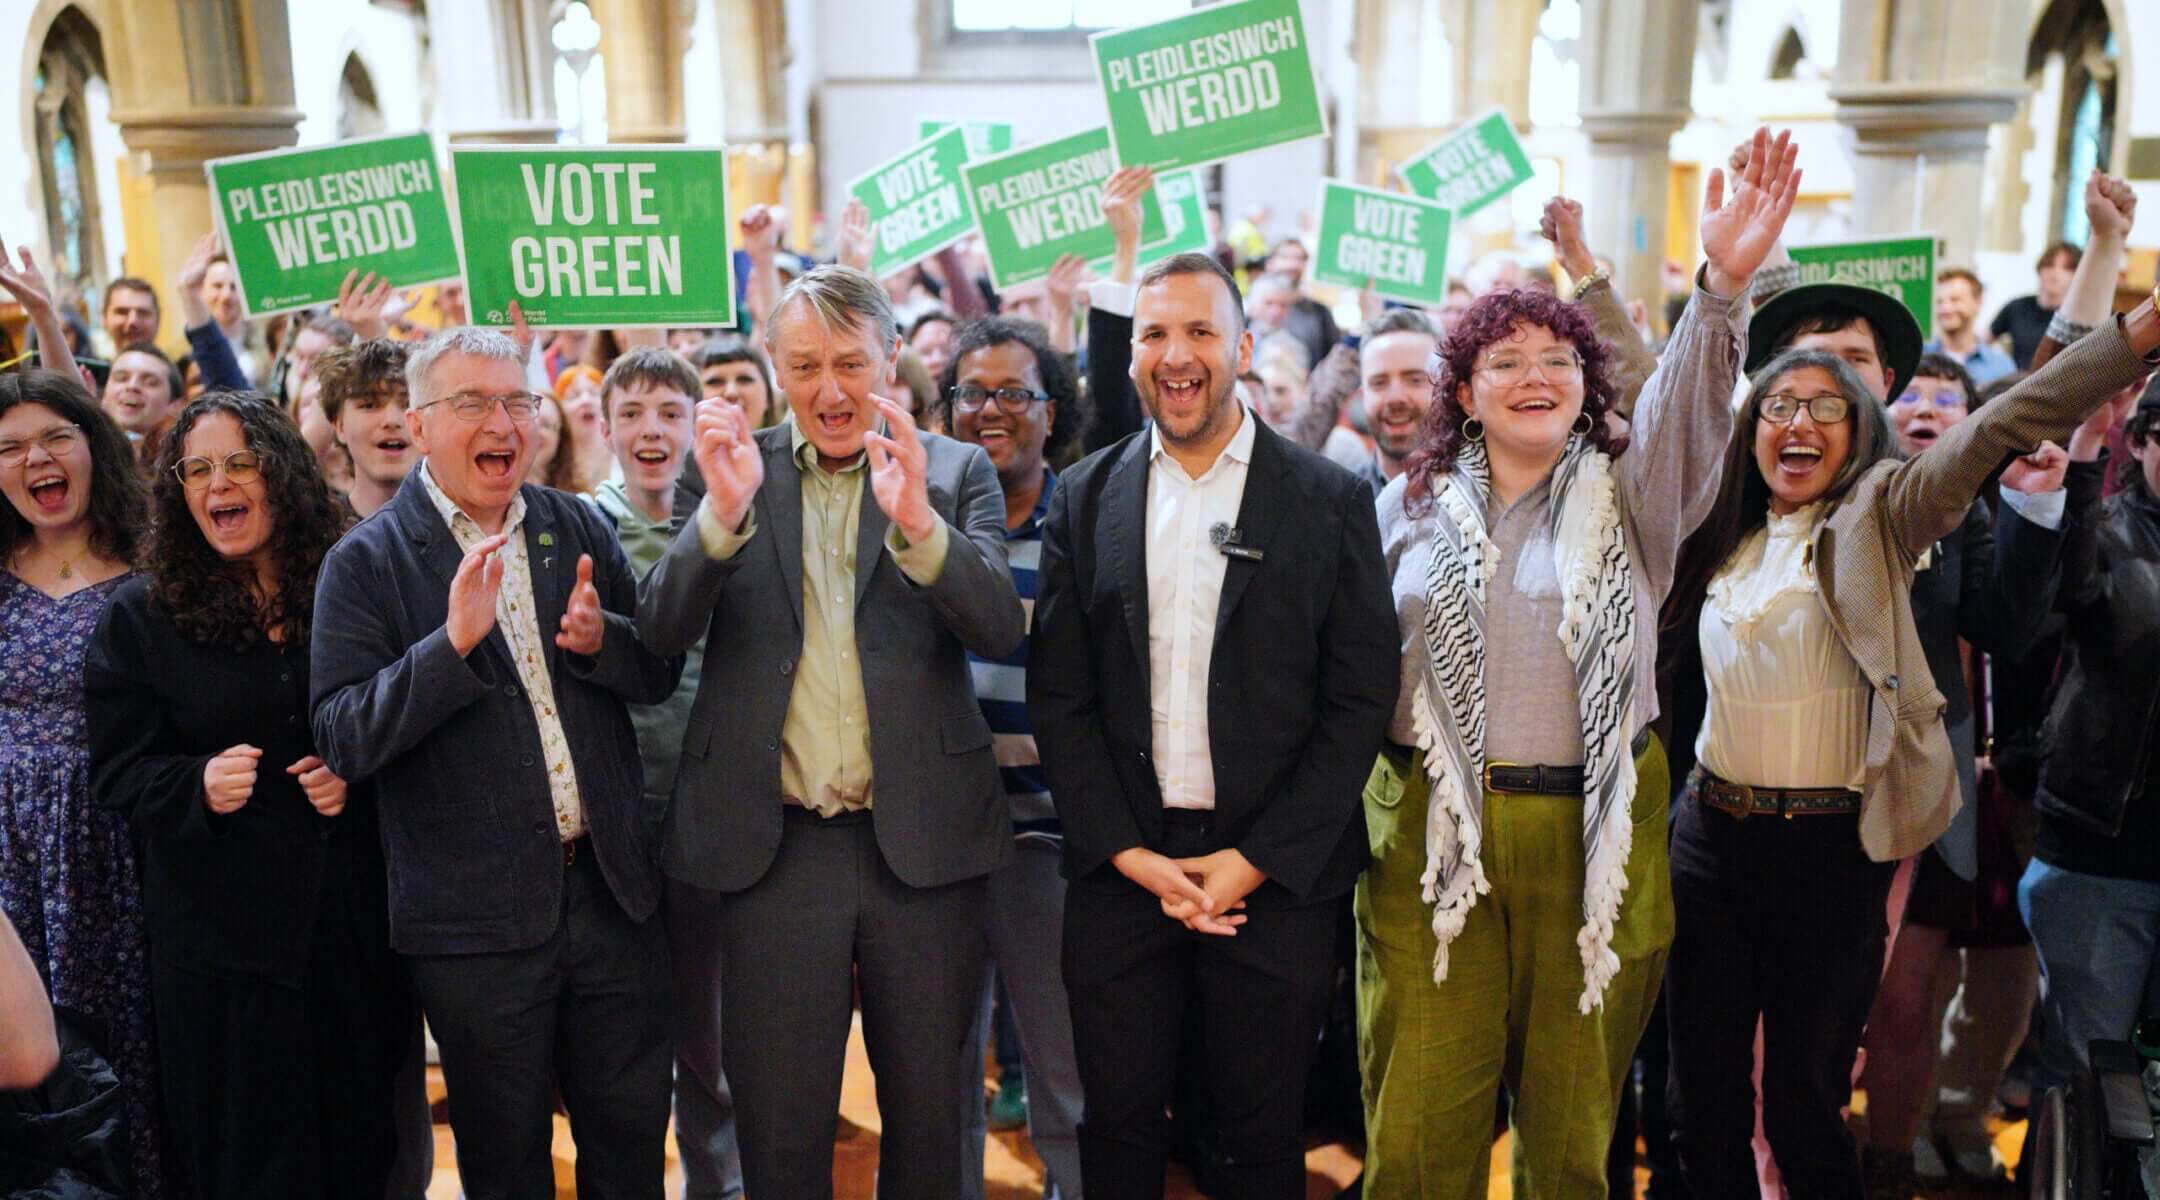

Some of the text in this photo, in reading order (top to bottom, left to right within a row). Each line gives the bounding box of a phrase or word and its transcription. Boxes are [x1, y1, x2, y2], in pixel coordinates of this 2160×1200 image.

[1107, 16, 1297, 93] PLEIDLEISIWCH
[1139, 59, 1281, 136] WERDD
[876, 146, 944, 209] VOTE
[977, 148, 1112, 214] PLEIDLEISIW
[1426, 127, 1490, 180] VOTE
[228, 158, 433, 224] PLEIDLEISIWCH
[520, 162, 660, 226] VOTE
[879, 182, 962, 255] GREEN
[1007, 185, 1108, 249] WERD
[1353, 193, 1424, 244] VOTE
[264, 200, 417, 271] WERDD
[511, 235, 683, 298] GREEN
[1337, 232, 1427, 287] GREEN
